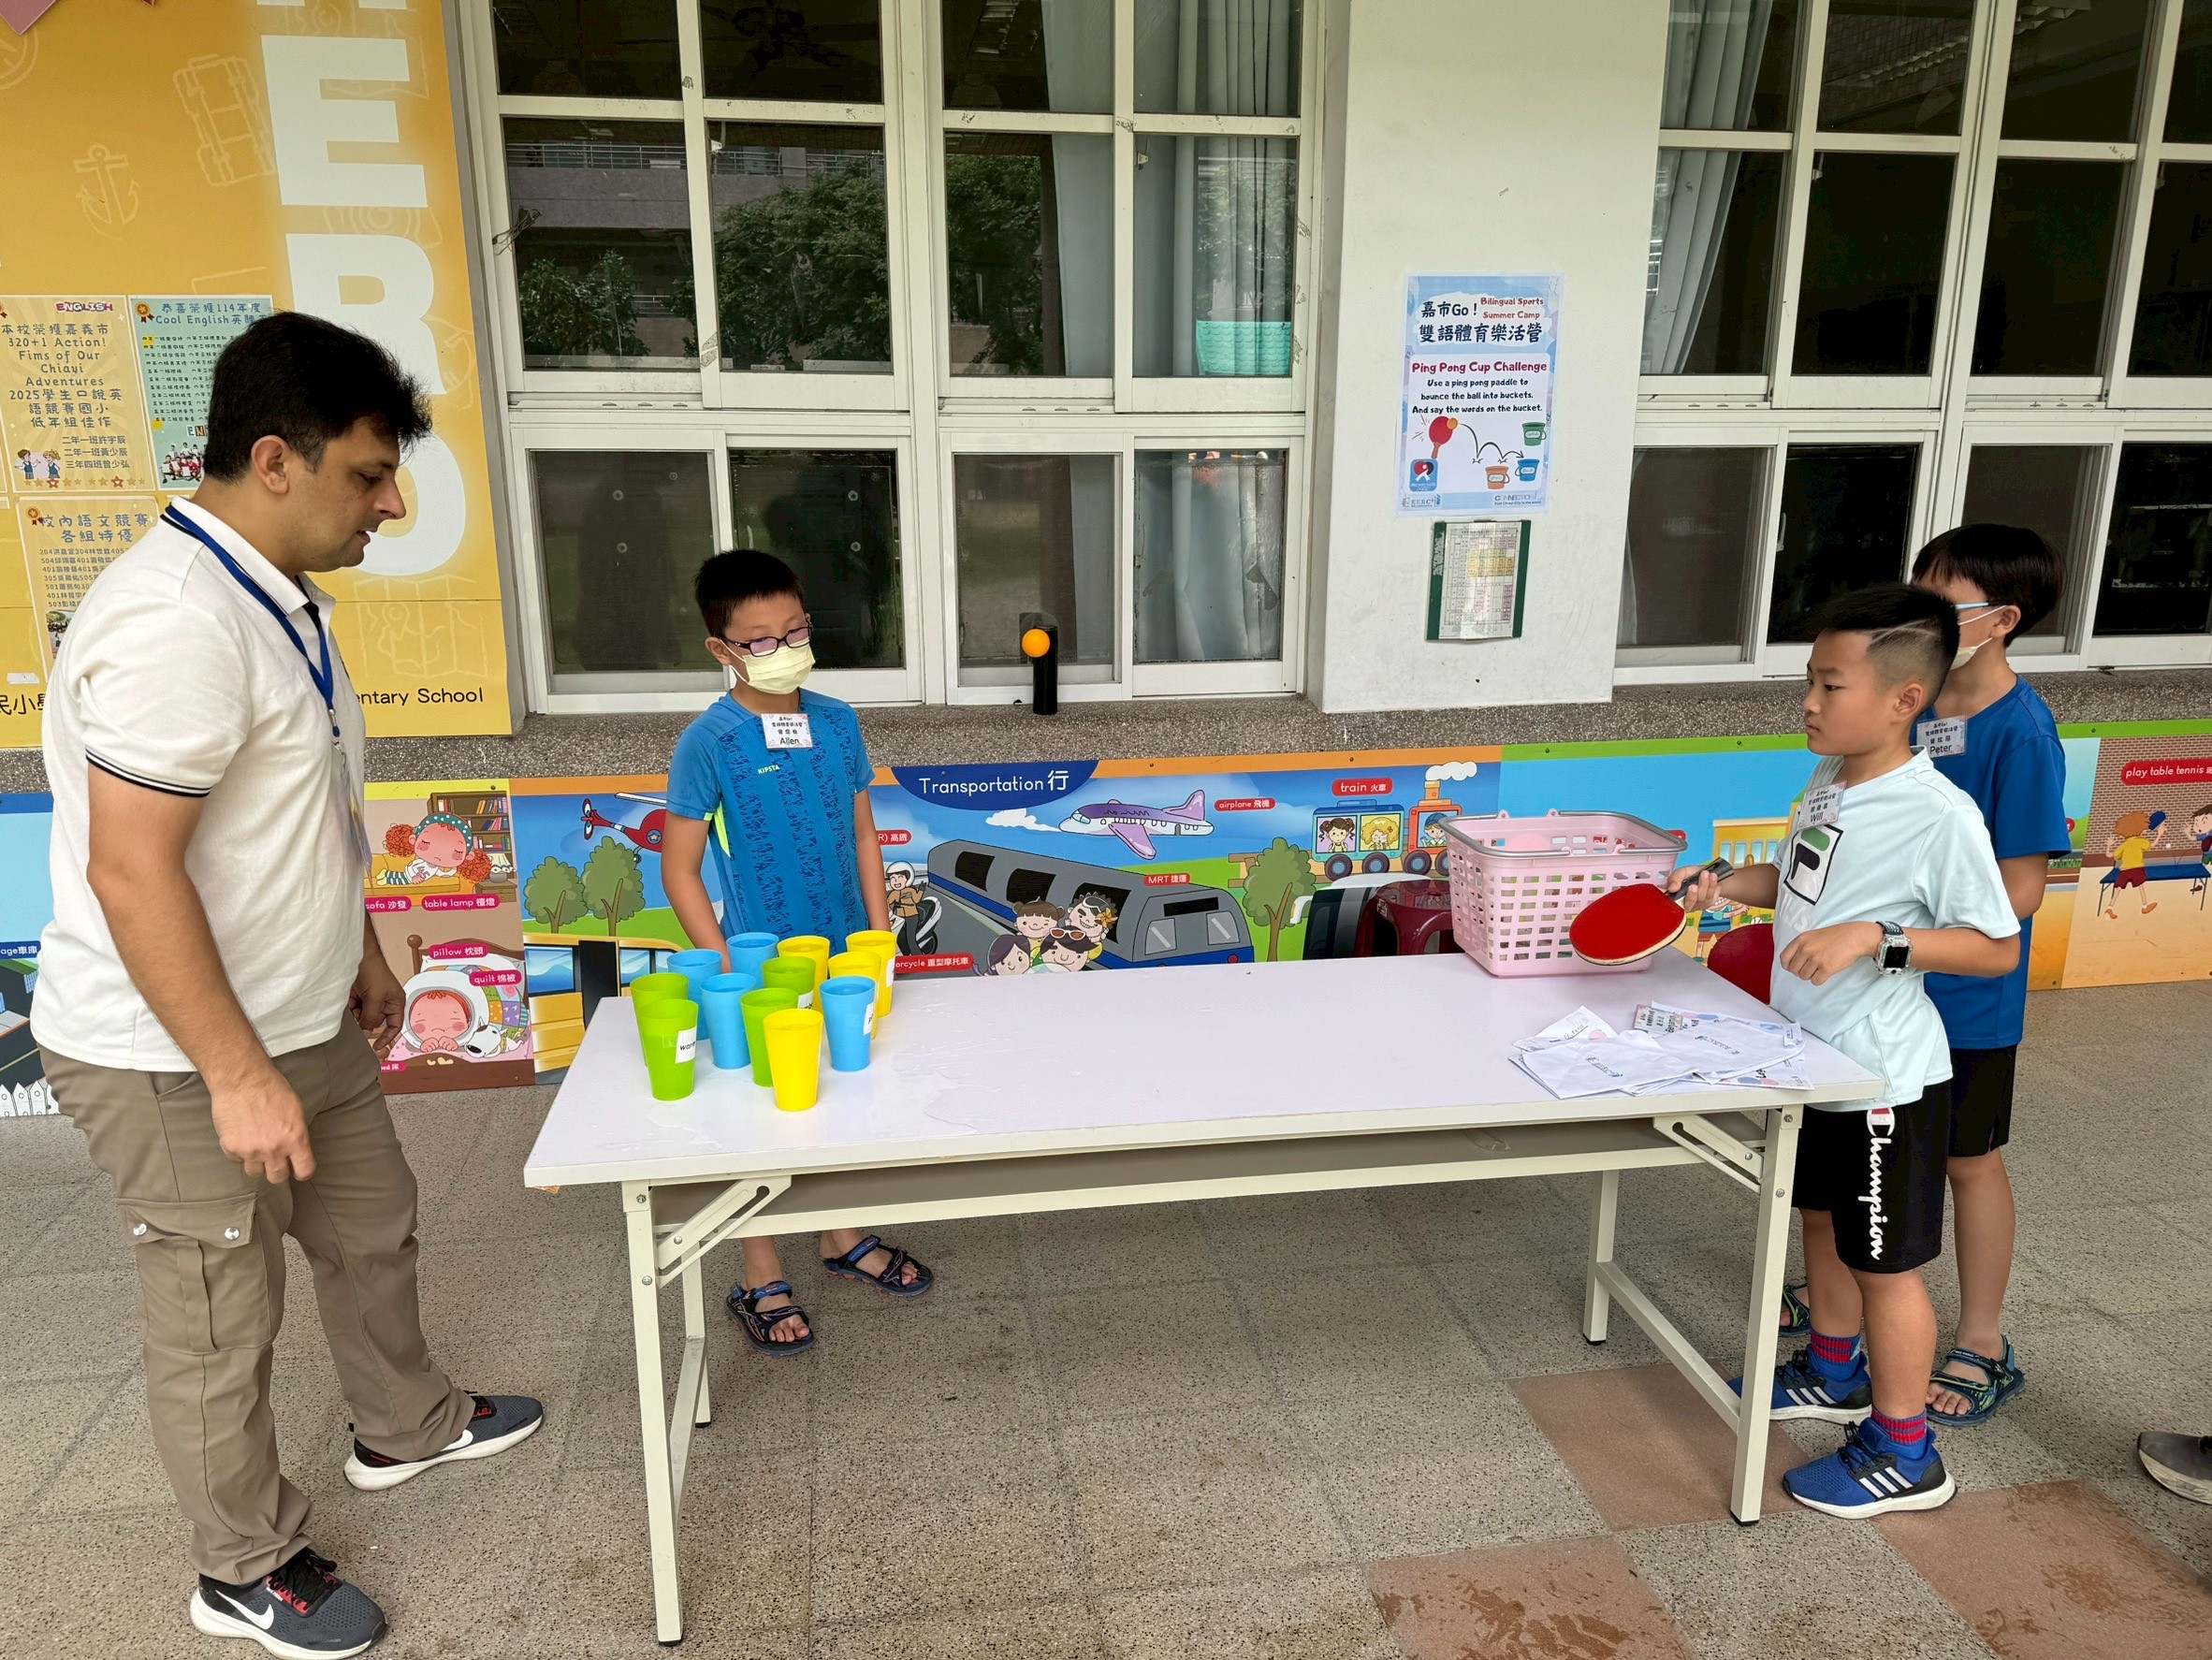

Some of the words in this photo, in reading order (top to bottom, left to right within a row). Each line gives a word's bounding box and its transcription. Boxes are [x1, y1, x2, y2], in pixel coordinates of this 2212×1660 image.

[255, 0, 466, 576] ERO
[56, 301, 113, 313] ENGLISH
[1480, 298, 1516, 306] Bilingual
[1518, 298, 1544, 306] Sports
[155, 314, 182, 325] Cool
[1517, 311, 1540, 320] Camp
[2, 323, 109, 335] 本校榮獲嘉義市
[1419, 322, 1543, 342] 雙語體育樂活營
[8, 338, 47, 347] 320+1
[54, 338, 107, 347] Action!
[19, 350, 50, 360] Fims
[56, 351, 70, 363] of
[77, 350, 100, 360] Our
[40, 363, 84, 376] Chiayi
[1412, 362, 1436, 374] Ping
[1439, 362, 1466, 374] Pong
[1469, 361, 1491, 374] Cup
[1493, 360, 1548, 372] Challenge
[25, 376, 104, 386] Adventures
[1451, 379, 1468, 387] ping
[1491, 378, 1518, 387] paddle
[9, 388, 123, 401] 2025學生口說英
[29, 402, 109, 415] 語競賽國小
[1412, 405, 1428, 414] And
[30, 416, 111, 429] 低年組佳作
[61, 529, 133, 543] 各組特優
[417, 687, 483, 703] School
[1929, 745, 1952, 754] Peter
[758, 764, 780, 774] KIPSTA
[2125, 767, 2147, 779] play
[2150, 765, 2174, 776] table
[2176, 764, 2204, 775] tennis
[919, 776, 1043, 796] Transportation
[1047, 770, 1070, 792] 行
[1340, 782, 1367, 793] train
[1370, 783, 1387, 793] 火車
[1219, 800, 1252, 809] airplane
[1253, 799, 1270, 808] 飛機
[1148, 875, 1171, 884] MRT
[387, 900, 407, 910] 沙發
[424, 899, 448, 908] table
[450, 898, 473, 910] lamp
[432, 947, 462, 957] pillow
[464, 946, 484, 955] 枕頭
[473, 973, 496, 984] quilt
[497, 973, 517, 983] 棉被
[1857, 1107, 1896, 1260] Champion
